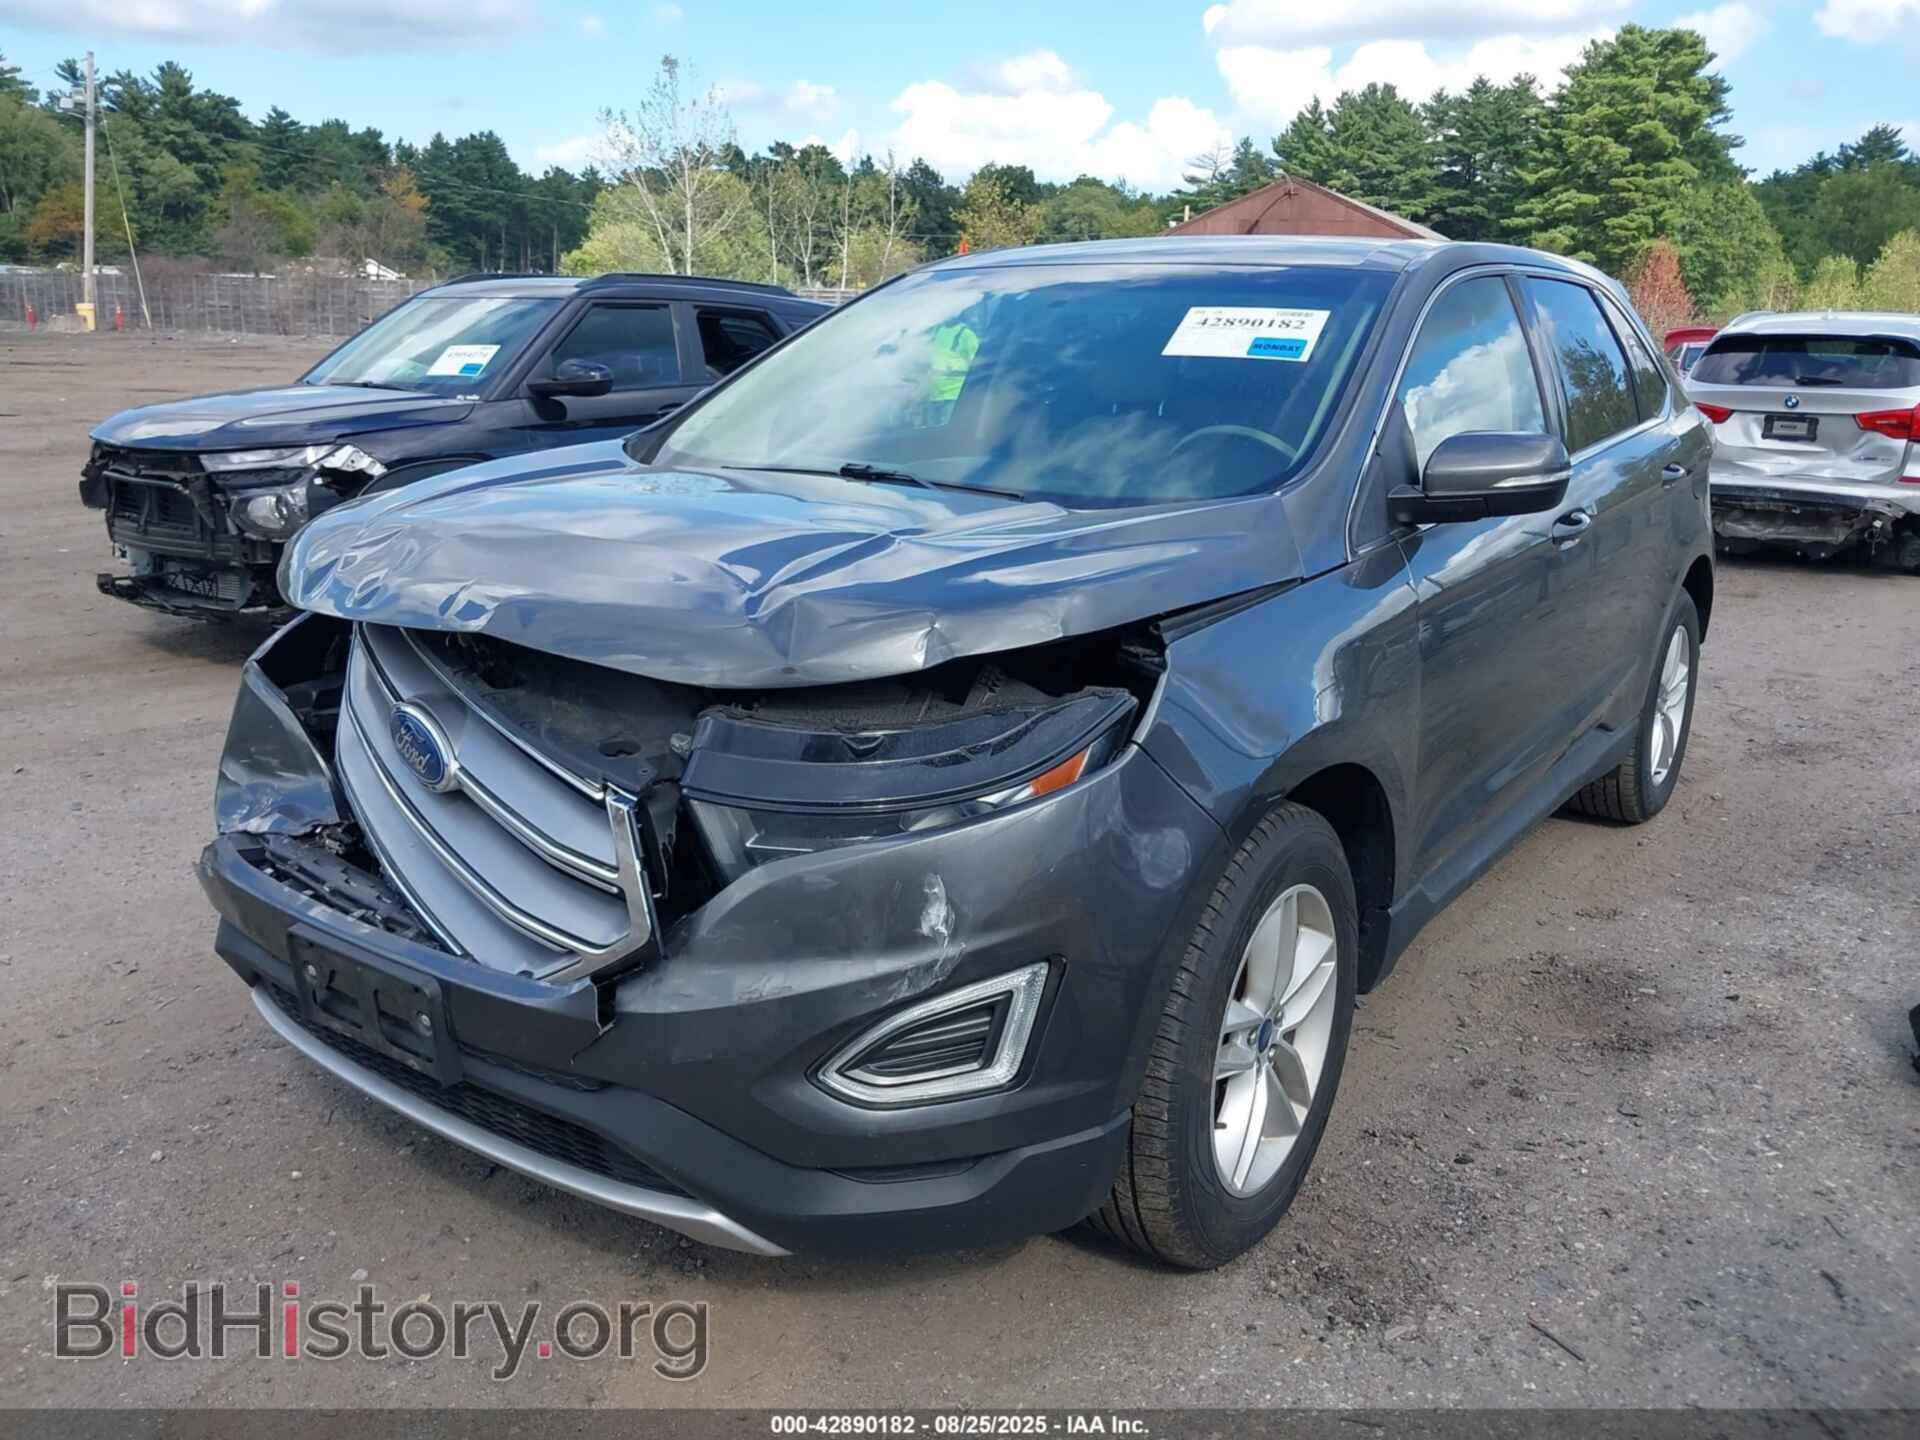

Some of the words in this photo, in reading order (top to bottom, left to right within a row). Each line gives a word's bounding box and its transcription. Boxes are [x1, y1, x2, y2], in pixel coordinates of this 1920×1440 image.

[1195, 317, 1306, 330] 42890182
[1252, 342, 1301, 353] MONDAY
[396, 721, 431, 774] Ford
